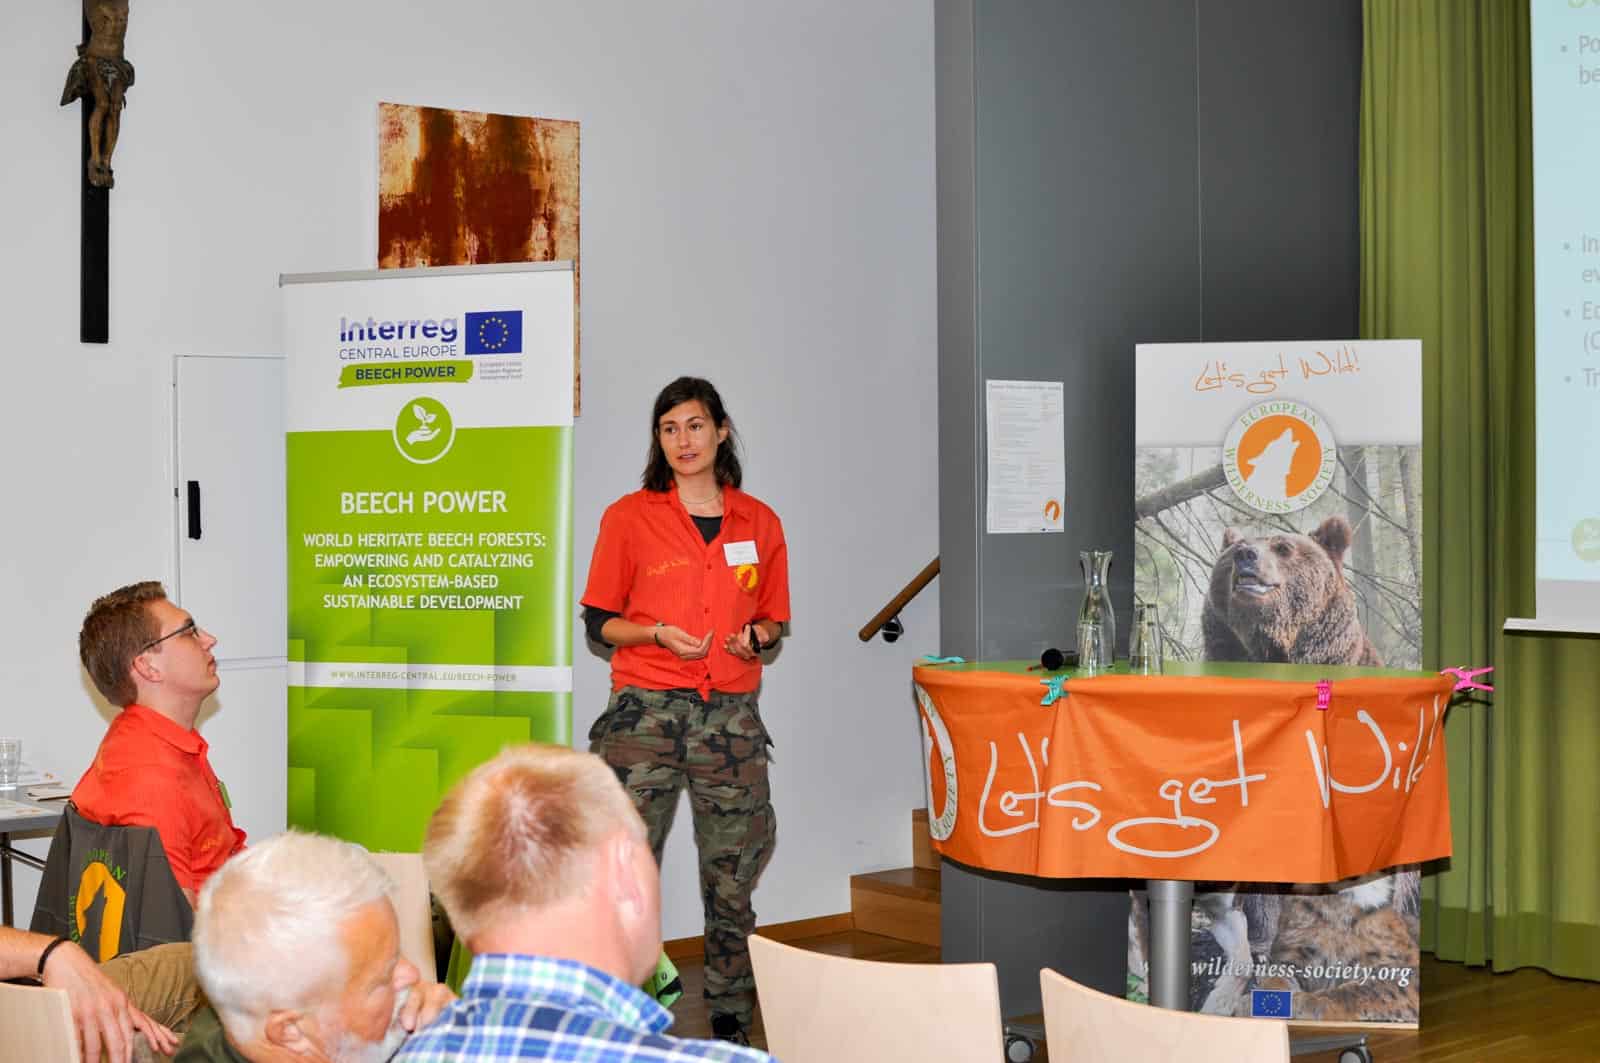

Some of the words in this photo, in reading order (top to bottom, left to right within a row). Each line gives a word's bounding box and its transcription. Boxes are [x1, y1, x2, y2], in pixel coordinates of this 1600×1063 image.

[340, 316, 458, 343] Interreg
[339, 347, 399, 360] CENTRAL
[403, 345, 457, 358] EUROPE
[355, 367, 401, 381] BEECH
[405, 366, 457, 379] POWER
[1195, 360, 1245, 391] Let's
[1246, 352, 1289, 393] get
[1240, 402, 1318, 427] EUROPEAN
[340, 491, 414, 514] BEECH
[423, 490, 508, 513] POWER
[303, 533, 353, 547] WORLD
[358, 533, 422, 547] HERITATE
[428, 532, 473, 547] BEECH
[478, 532, 547, 547] FORESTS:
[315, 554, 409, 568] EMPOWERING
[413, 554, 443, 568] AND
[448, 553, 534, 568] CATALYZING
[343, 575, 363, 588] AN
[368, 574, 498, 589] ECOSYSTEM-BASED
[323, 595, 415, 609] SUSTAINABLE
[419, 595, 524, 609] DEVELOPMENT
[978, 732, 1102, 837] Let's
[1107, 720, 1266, 858] get
